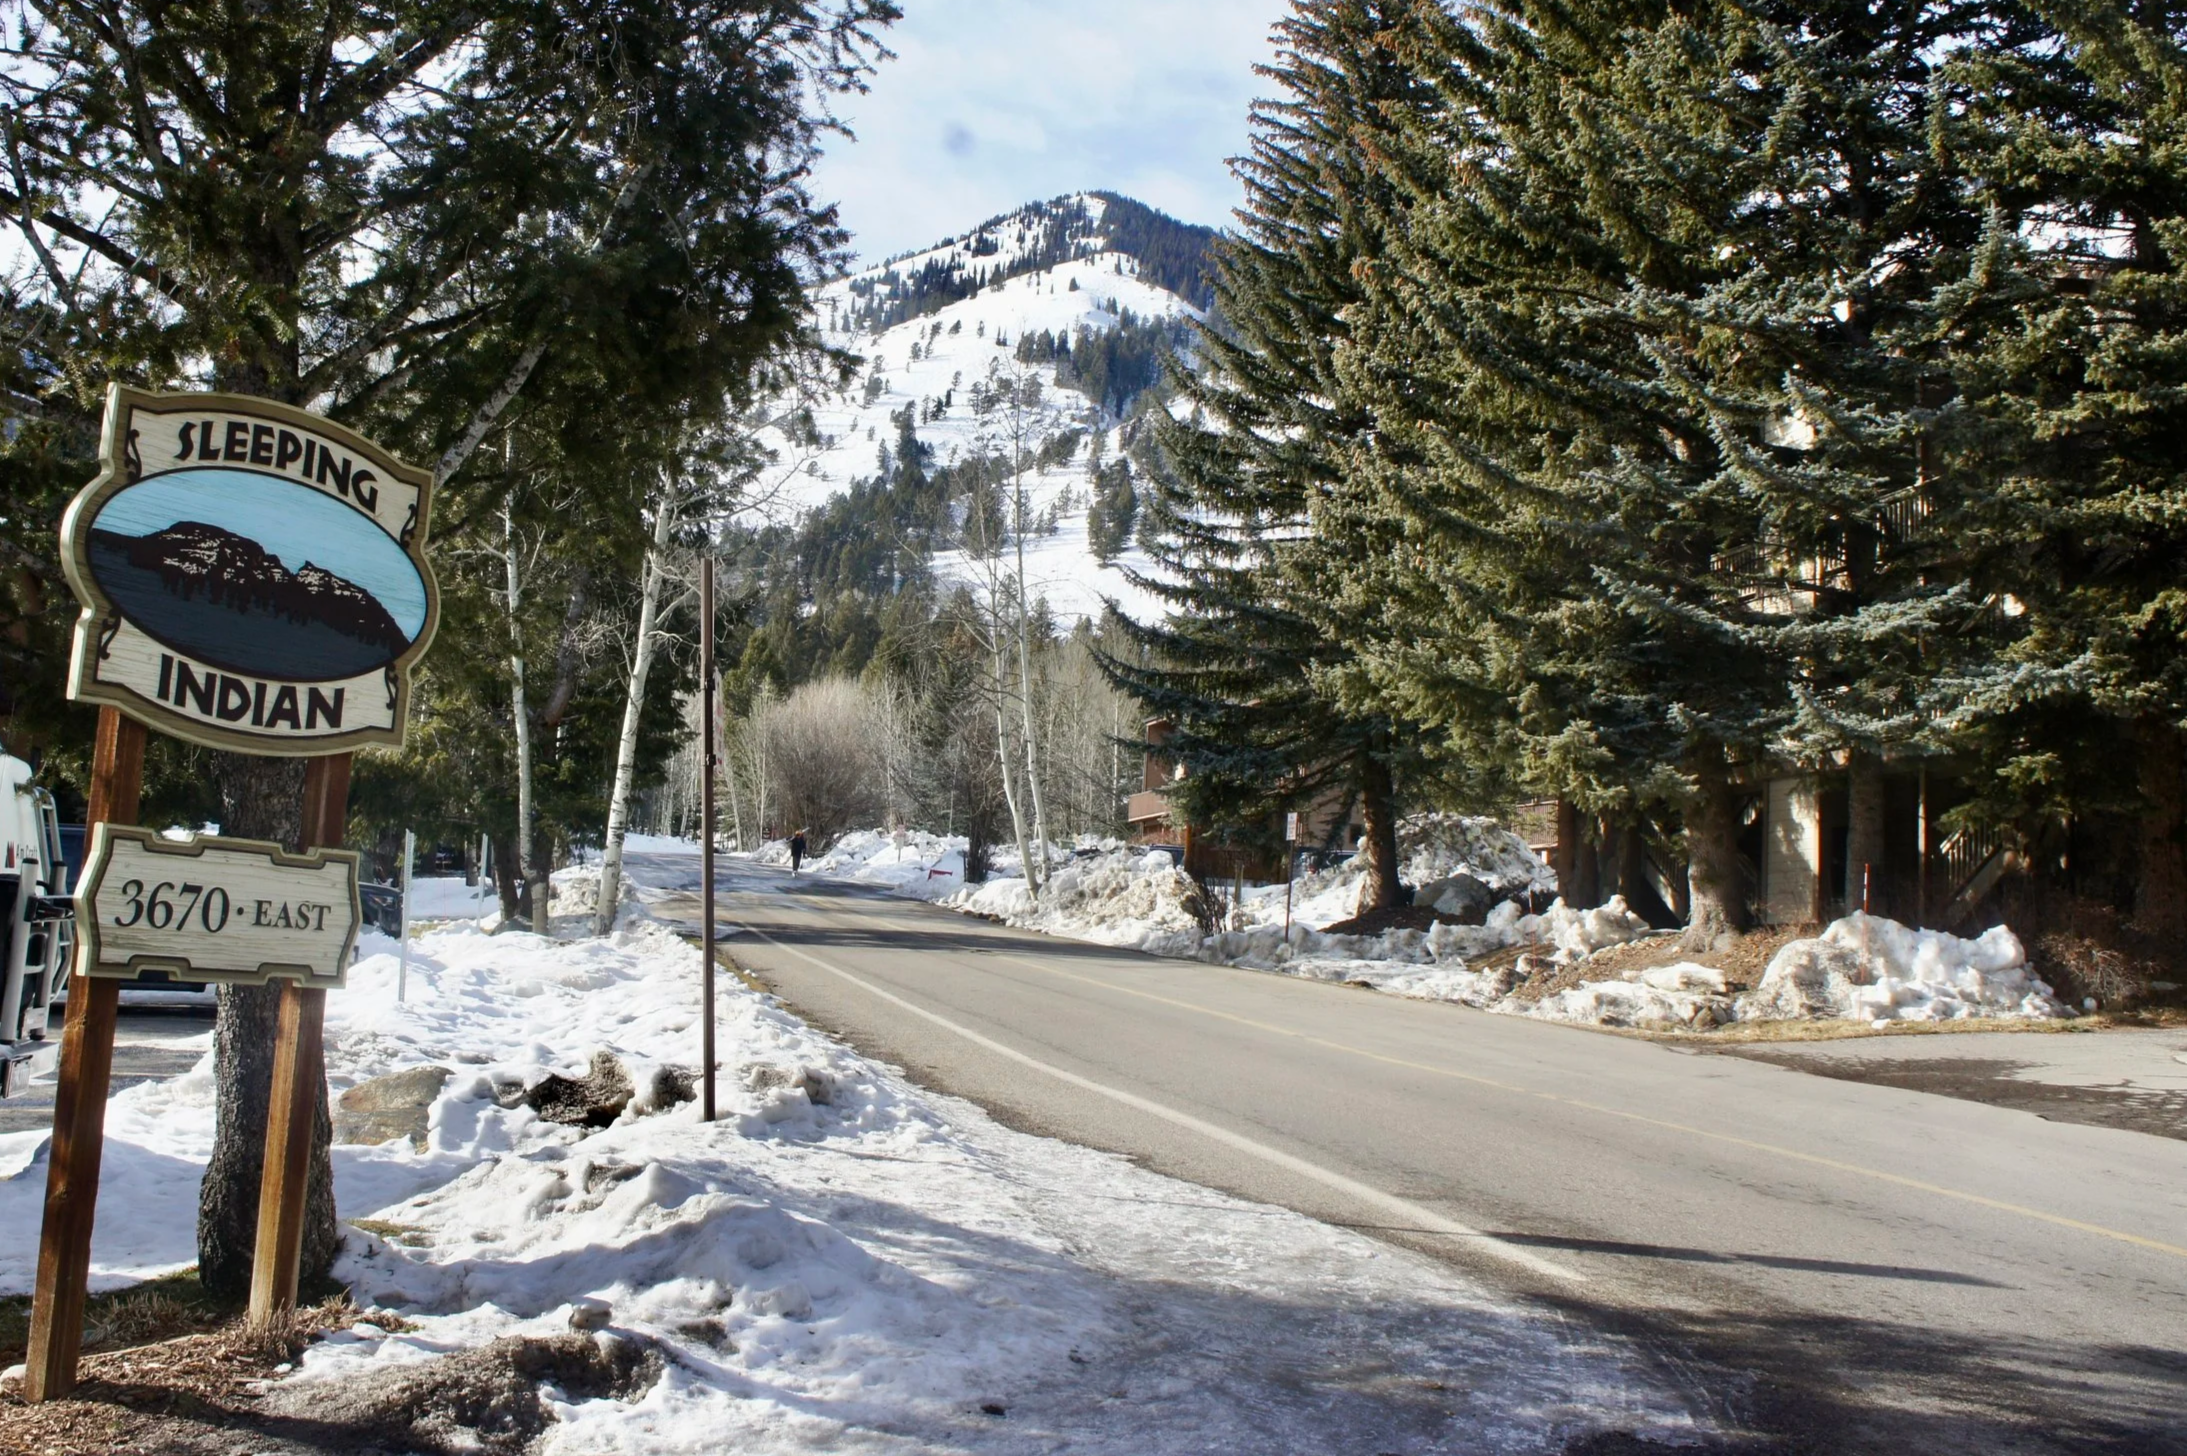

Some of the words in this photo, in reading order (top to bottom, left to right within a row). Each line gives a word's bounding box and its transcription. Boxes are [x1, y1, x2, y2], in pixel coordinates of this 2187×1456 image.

[174, 420, 378, 514] SLEEPING
[157, 653, 346, 730] INDIAN
[114, 879, 230, 933] 3670
[252, 899, 332, 931] EAST
